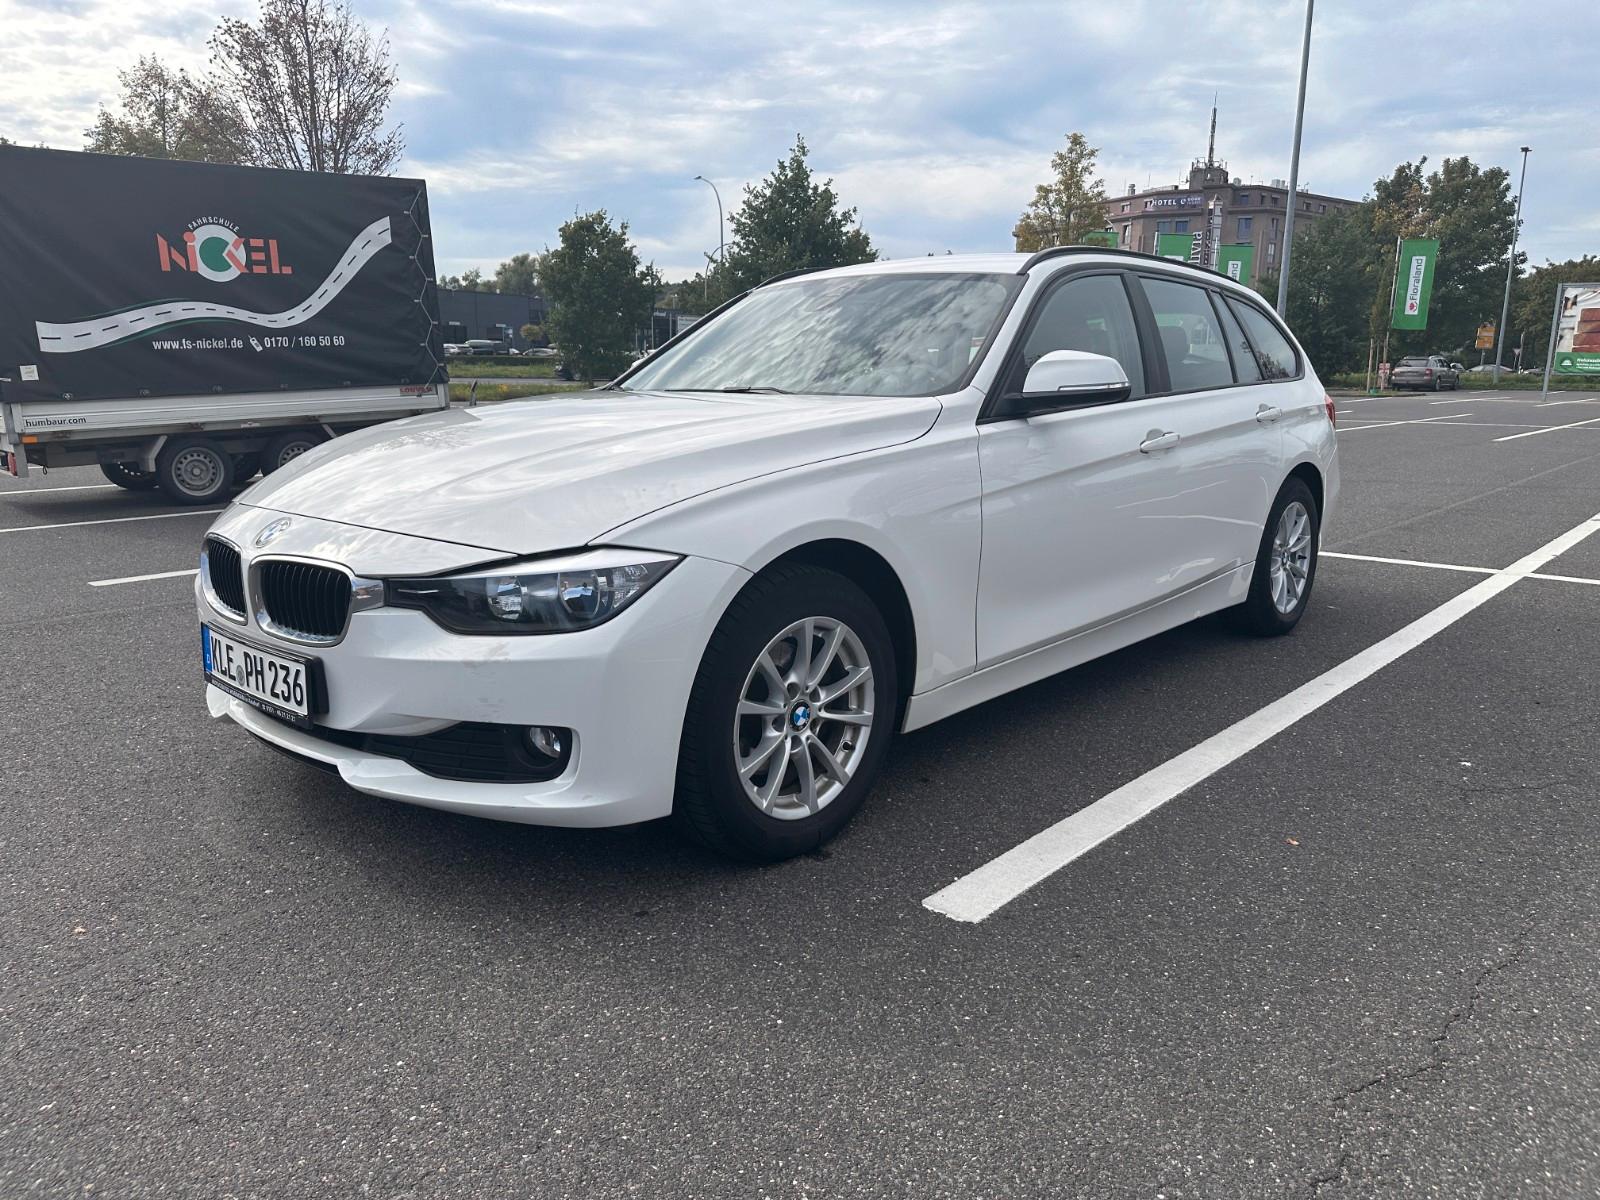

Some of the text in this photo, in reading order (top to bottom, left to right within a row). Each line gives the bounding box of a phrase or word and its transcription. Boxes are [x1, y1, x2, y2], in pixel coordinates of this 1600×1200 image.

[187, 216, 240, 233] FAHRSCHULE
[1409, 258, 1424, 301] Floraland
[152, 337, 244, 350] www.fs-nickel.de
[264, 337, 289, 348] 0170
[299, 336, 317, 347] 160
[319, 336, 331, 347] 50
[333, 336, 345, 346] 60
[25, 417, 87, 428] humbaur.com
[210, 636, 237, 681] KLE
[268, 660, 304, 707] 236
